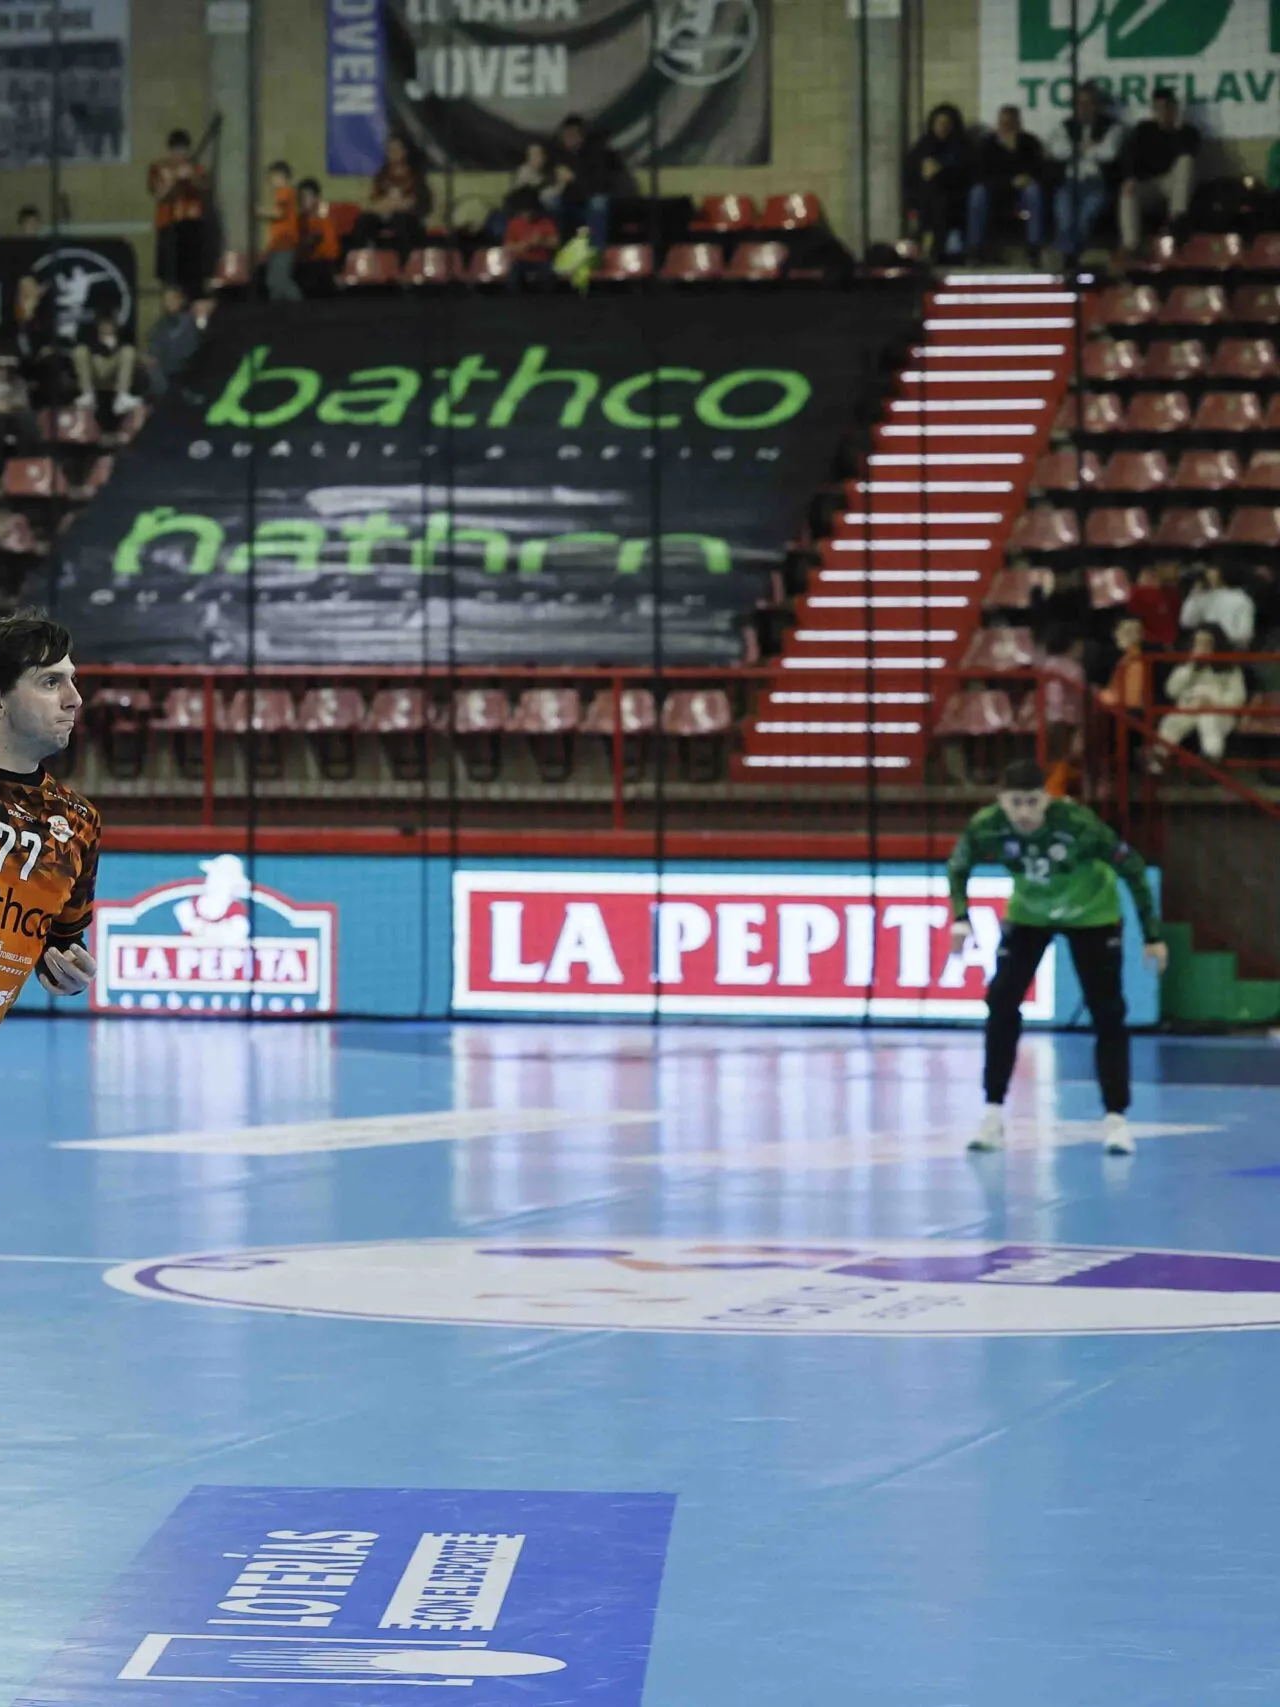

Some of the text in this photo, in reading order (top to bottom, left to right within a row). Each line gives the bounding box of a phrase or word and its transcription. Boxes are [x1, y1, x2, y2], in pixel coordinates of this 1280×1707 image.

[404, 44, 569, 100] JOVEN
[205, 346, 811, 429] bathco
[120, 946, 307, 982] LA PEPITA
[488, 900, 1008, 989] LA PEPITA
[206, 1530, 380, 1628] LOTERÍAS
[411, 1539, 499, 1622] CON EL DEPORTE
